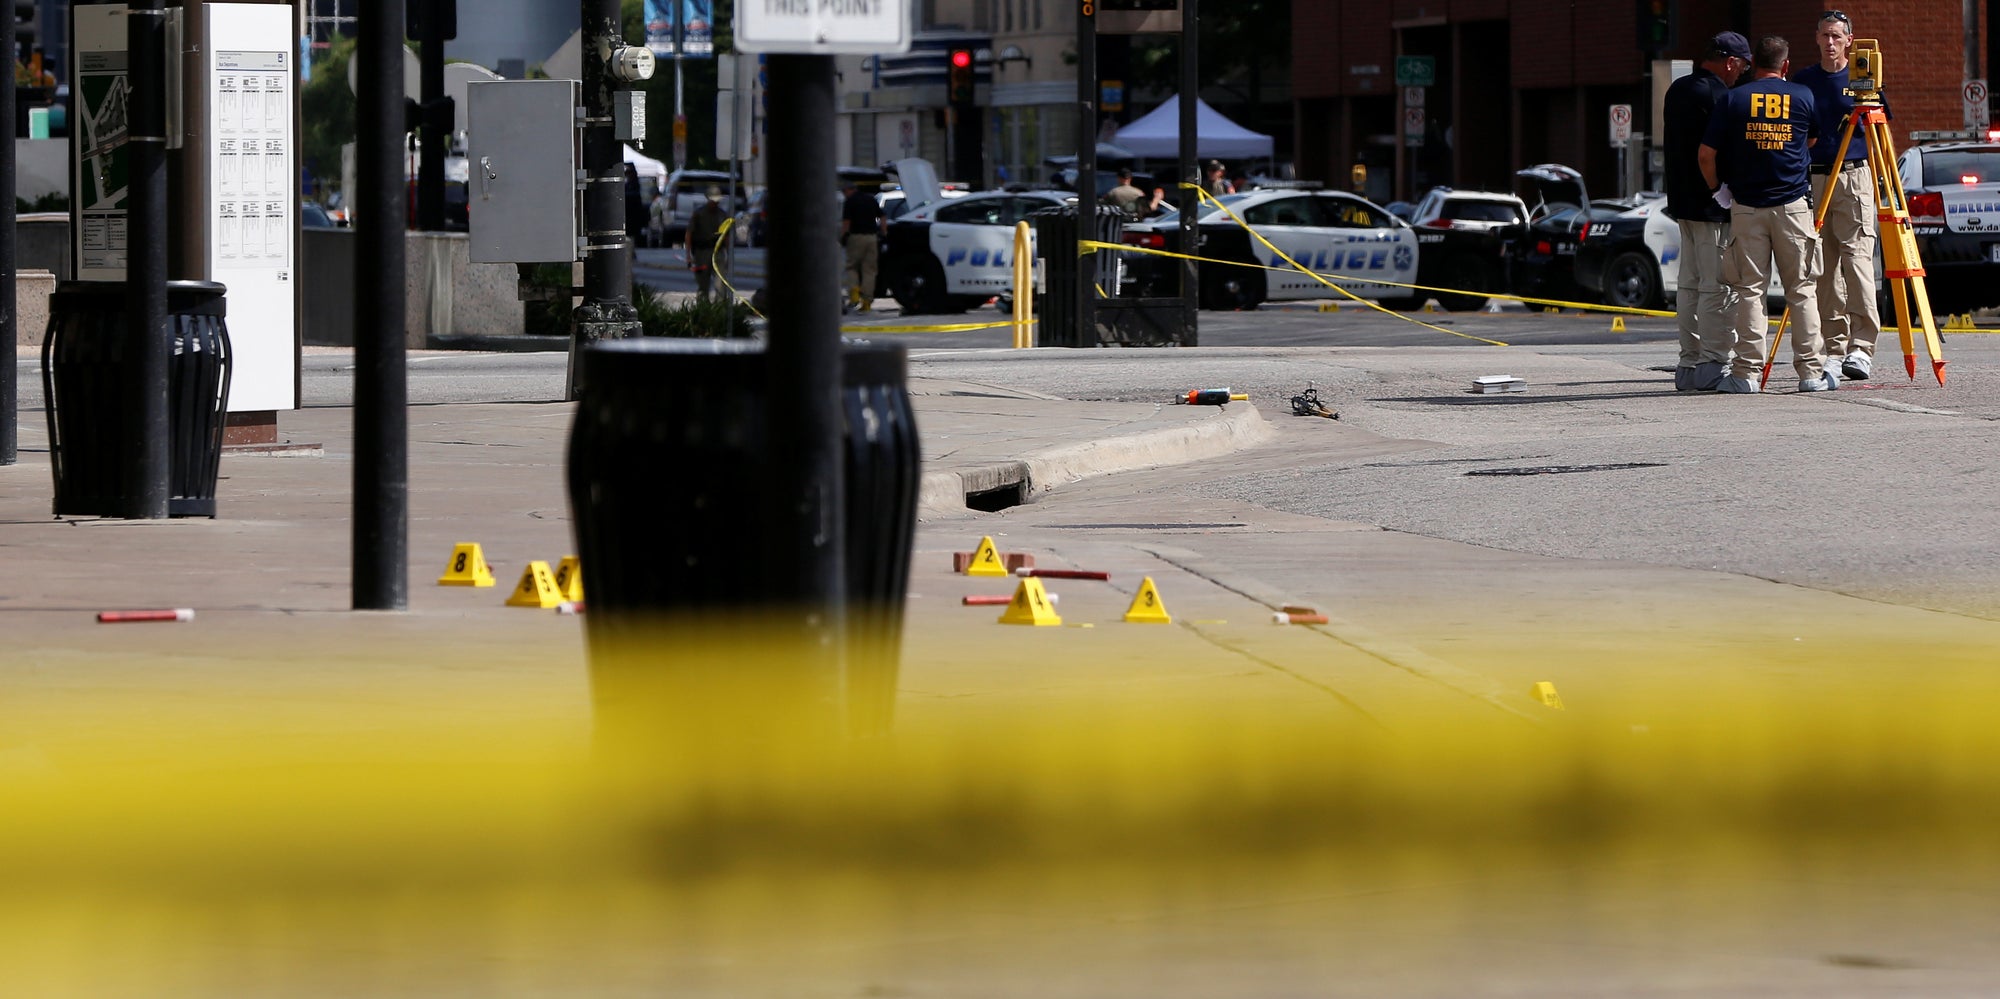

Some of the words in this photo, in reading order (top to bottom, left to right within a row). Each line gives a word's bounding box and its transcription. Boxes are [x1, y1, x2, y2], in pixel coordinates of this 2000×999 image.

[1751, 93, 1791, 119] FBI
[632, 105, 640, 127] 200
[1745, 131, 1793, 142] RESPONSE
[1746, 122, 1793, 133] EVIDENCE
[1756, 141, 1784, 150] TEAM
[1271, 249, 1389, 271] POLICE
[455, 552, 466, 573] 8
[984, 548, 994, 563] 2
[1034, 588, 1044, 612] 4
[1144, 590, 1154, 608] 3
